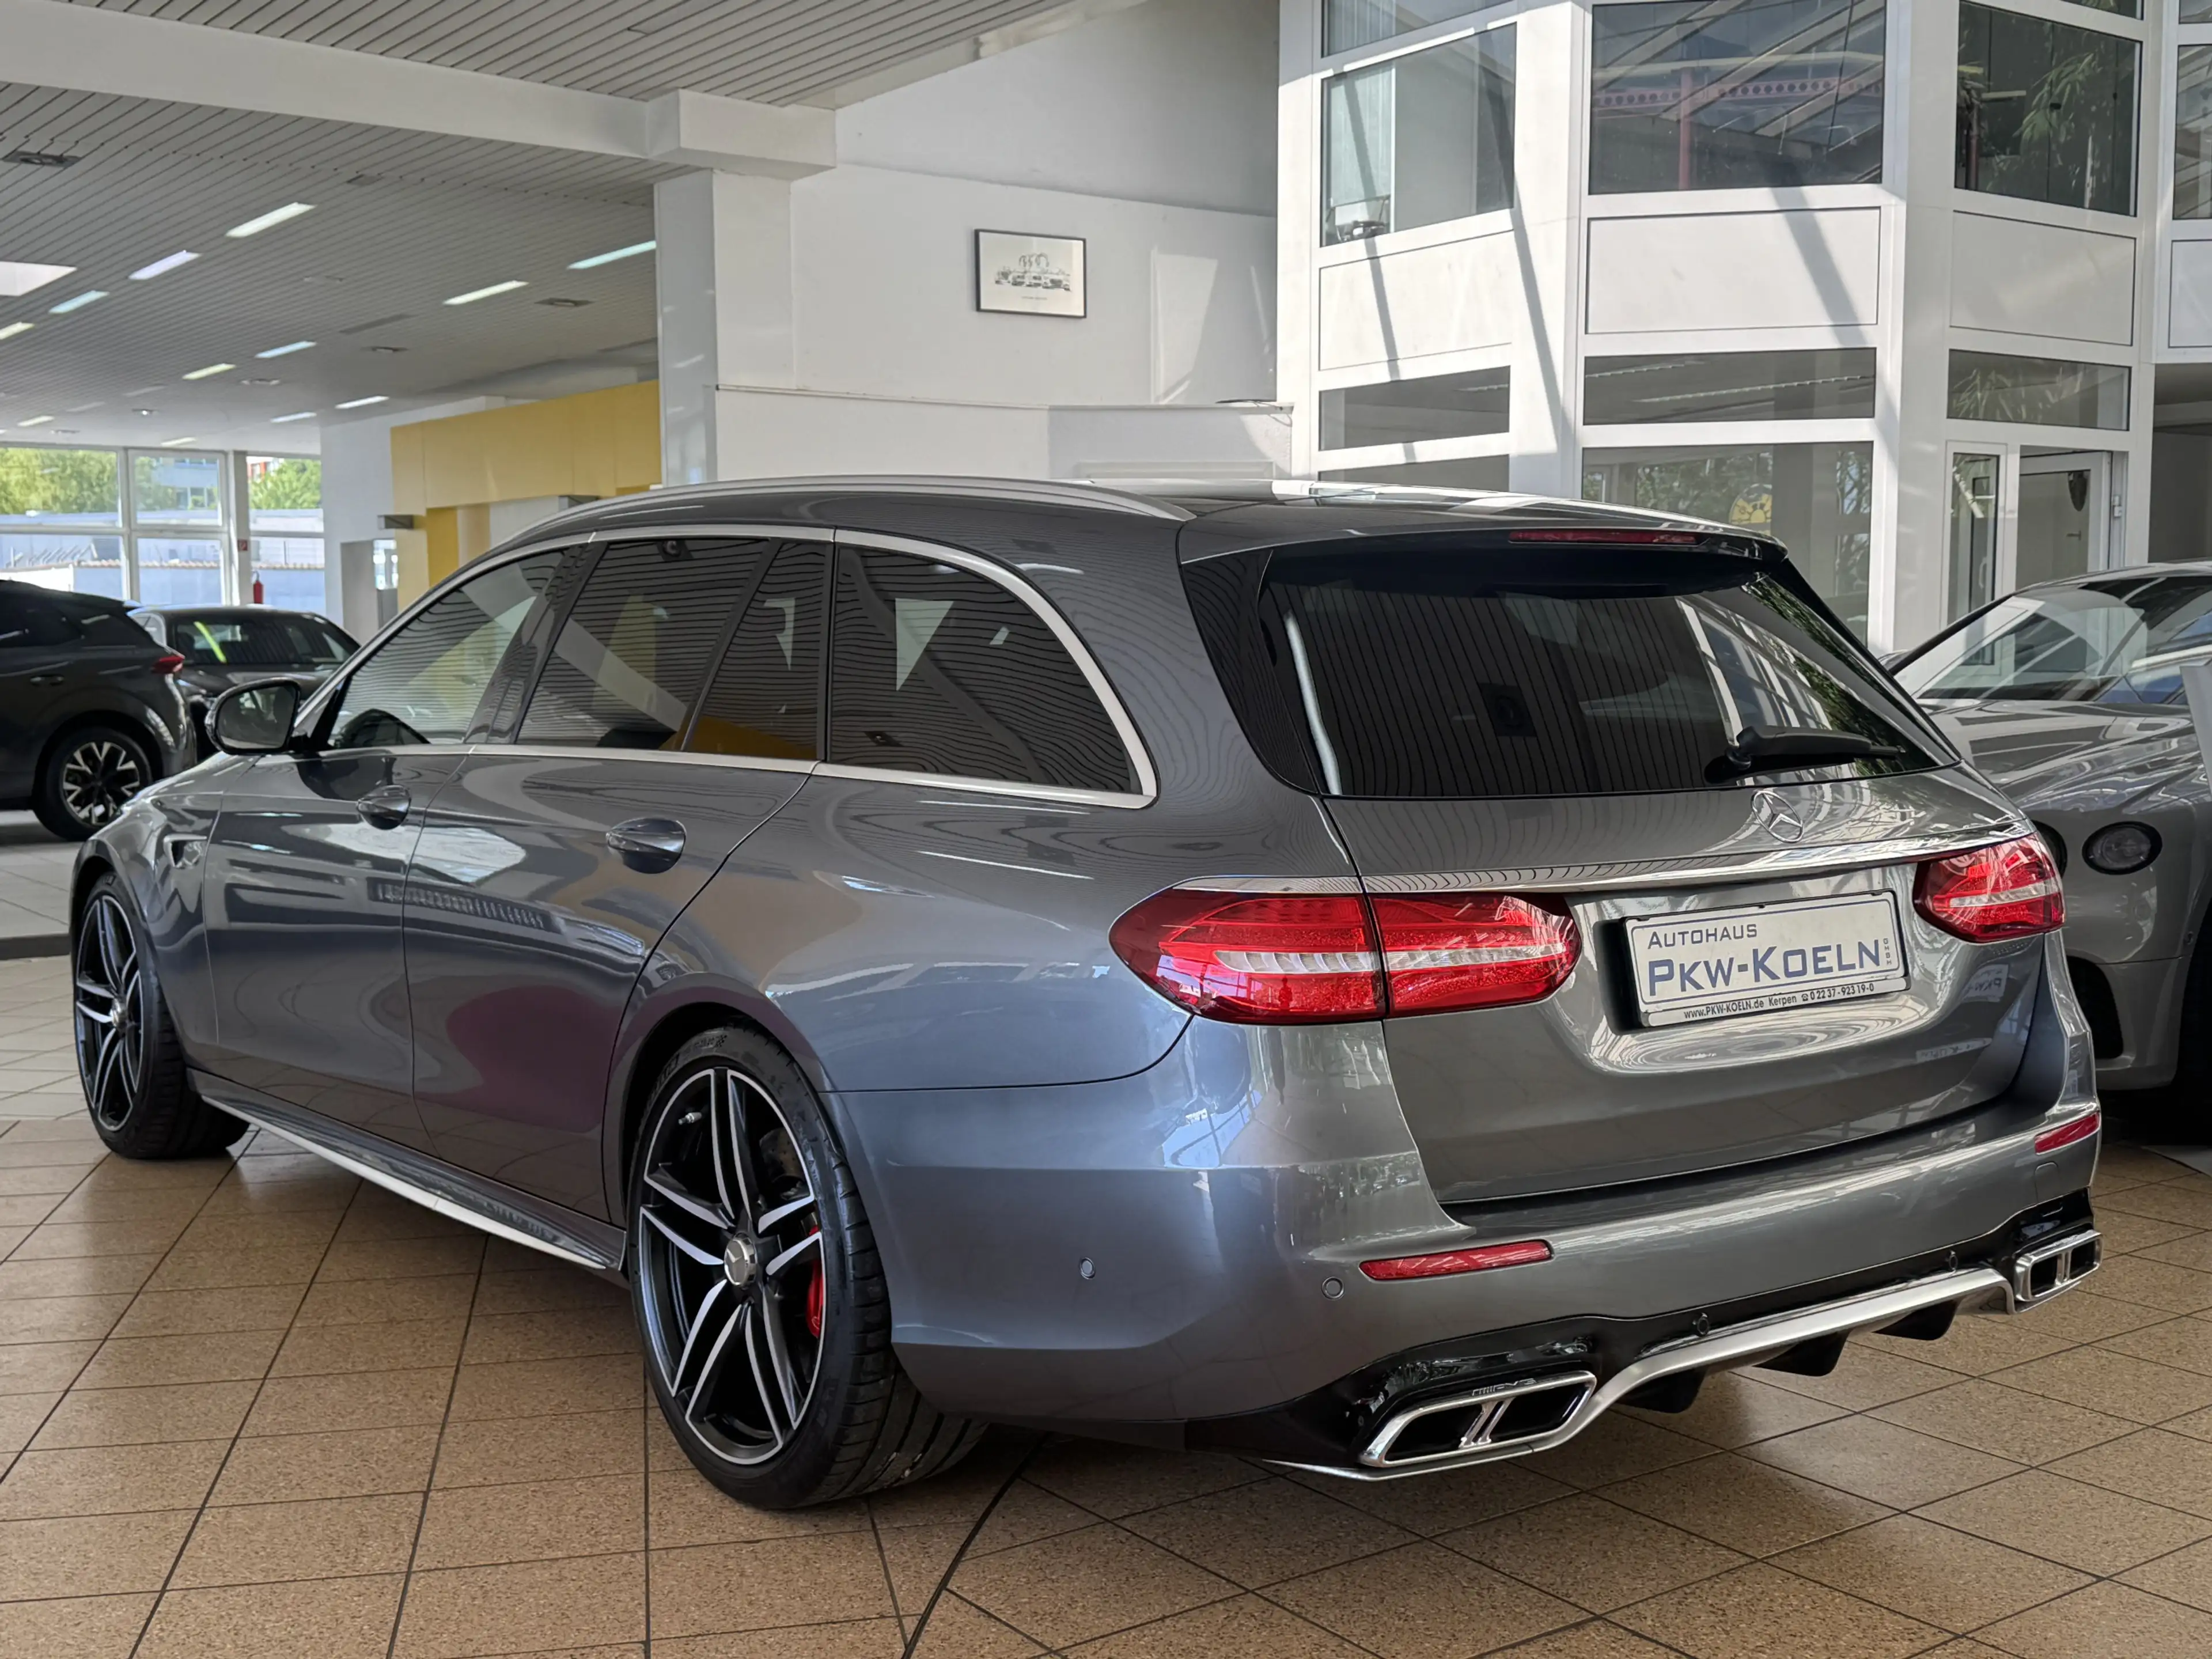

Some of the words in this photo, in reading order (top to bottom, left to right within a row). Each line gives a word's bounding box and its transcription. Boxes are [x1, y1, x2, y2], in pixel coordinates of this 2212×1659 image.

[1647, 924, 1758, 949] AUTOHAUS
[1648, 939, 1880, 996] PKW-KOELN
[1684, 999, 1764, 1019] www.PKW-KOELN.de
[1768, 995, 1797, 1007] Kerpen
